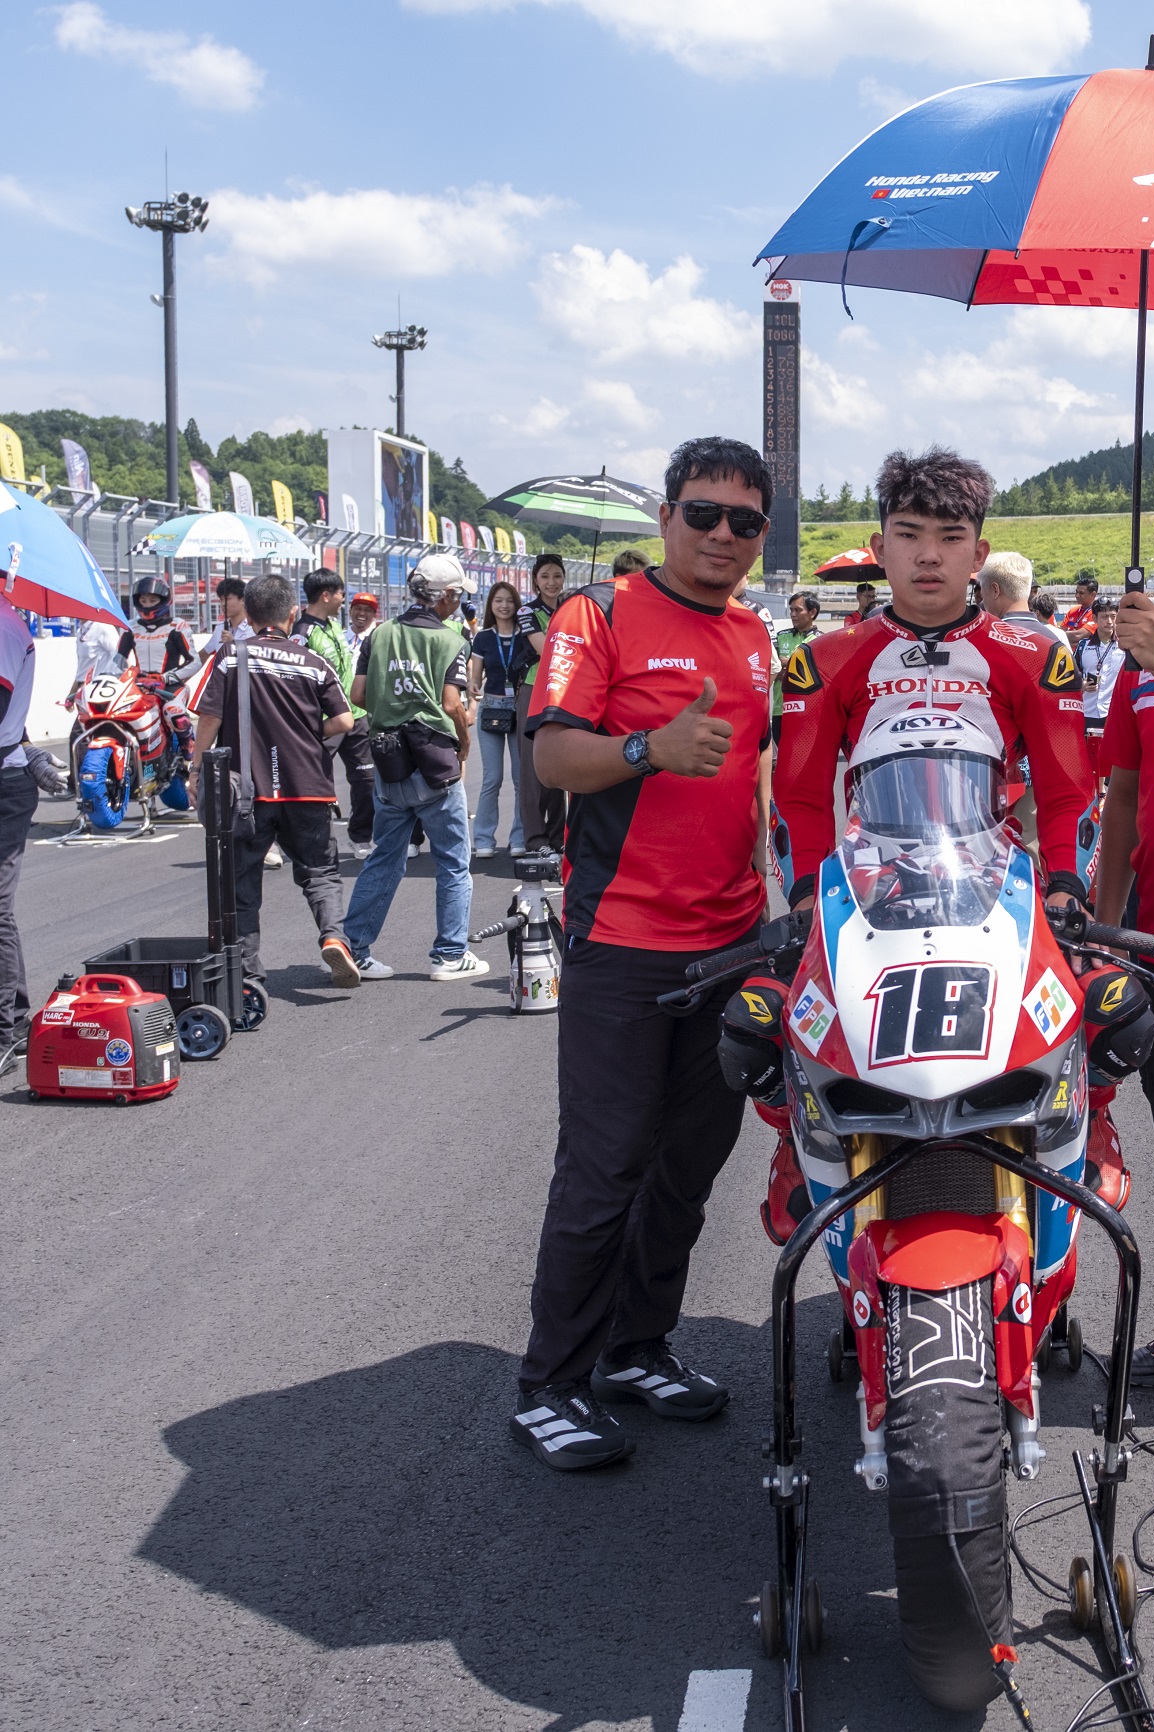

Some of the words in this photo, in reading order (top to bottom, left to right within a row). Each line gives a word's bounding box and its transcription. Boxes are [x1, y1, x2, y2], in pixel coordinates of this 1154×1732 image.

[865, 175, 931, 186] Honda
[929, 171, 1000, 183] Racing
[889, 186, 973, 198] Vietnam
[767, 346, 773, 356] 1
[767, 358, 774, 368] 2
[767, 369, 774, 380] 3
[767, 381, 774, 391] 4
[767, 393, 774, 403] 5
[767, 405, 774, 415] 6
[767, 416, 774, 427] 7
[767, 428, 774, 438] 8
[767, 440, 774, 450] 9
[953, 614, 985, 639] TAICH
[991, 632, 1036, 649] HONDA
[231, 644, 305, 665] SHITANI
[648, 658, 698, 671] MOTUL
[90, 680, 117, 698] 75
[869, 678, 991, 698] HONDA
[783, 703, 801, 711] NDA
[1063, 701, 1084, 710] HON
[1034, 980, 1067, 1034] FPT
[44, 1012, 64, 1020] HARC
[793, 994, 831, 1040] FPT
[866, 961, 997, 1069] 18
[1107, 1049, 1127, 1067] TAICHI
[753, 1065, 775, 1087] TAICHI
